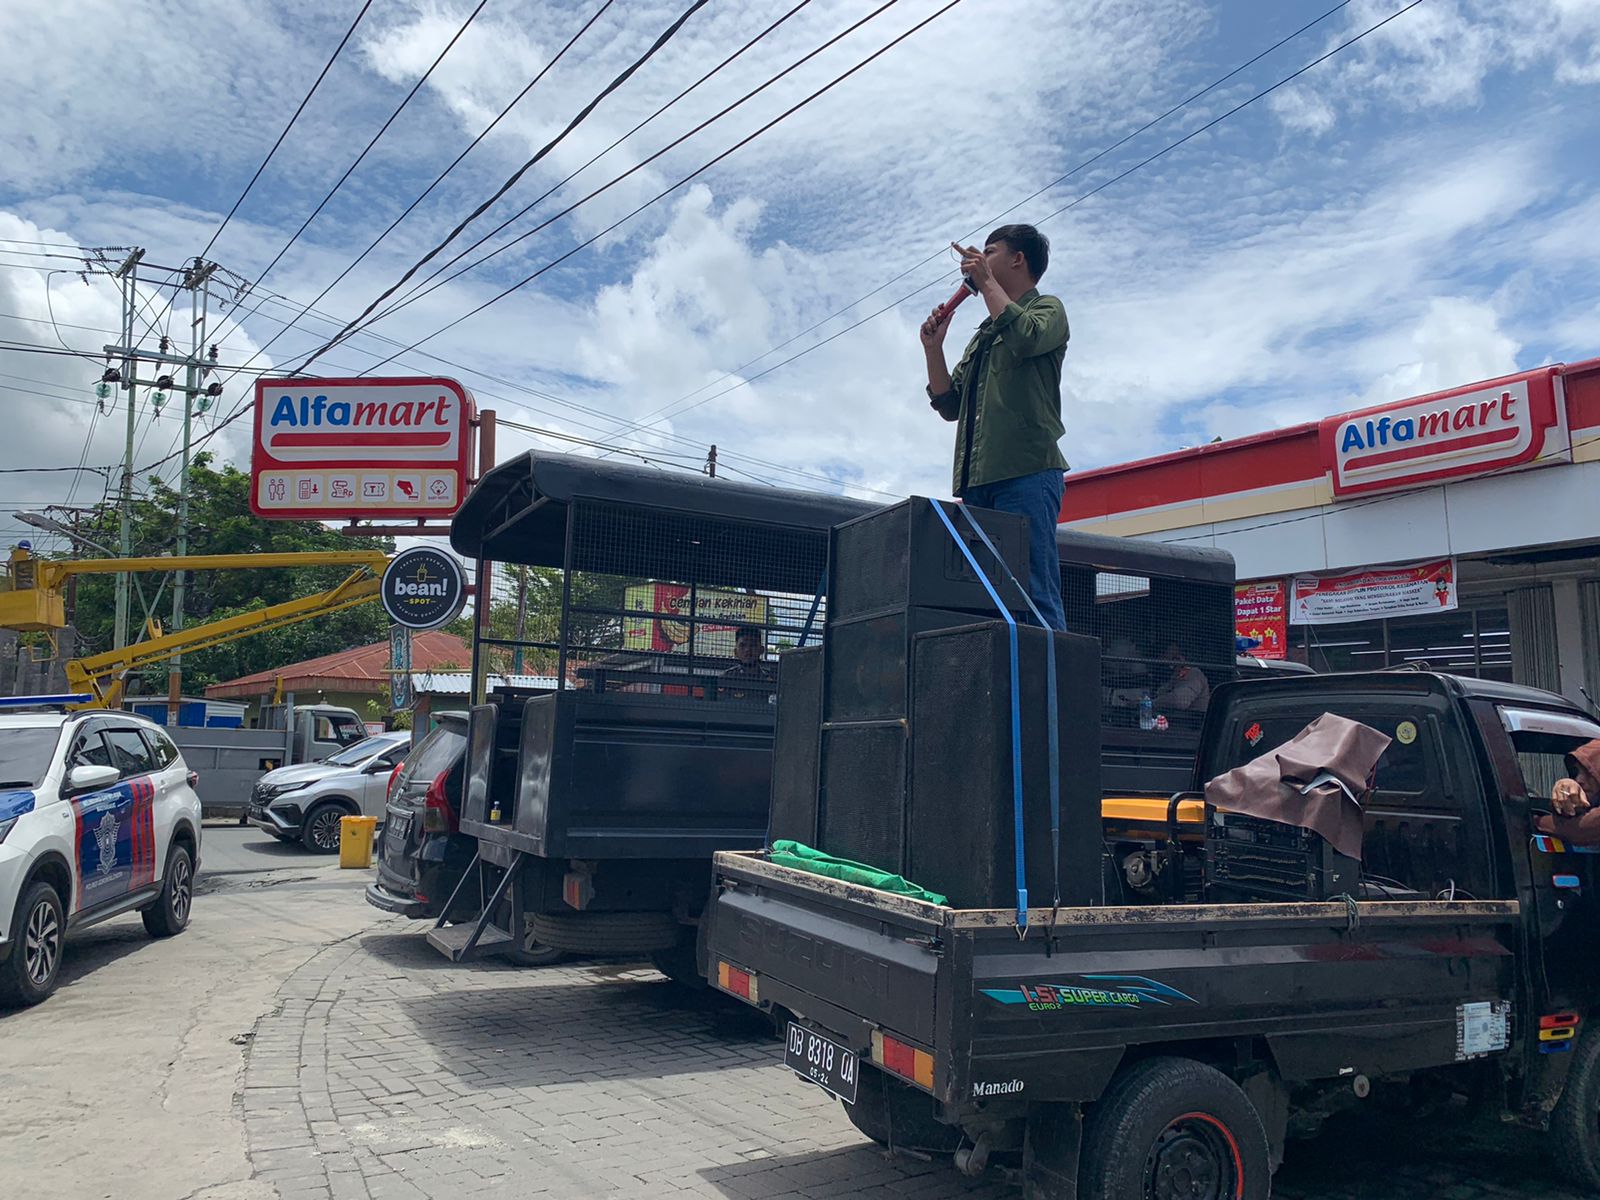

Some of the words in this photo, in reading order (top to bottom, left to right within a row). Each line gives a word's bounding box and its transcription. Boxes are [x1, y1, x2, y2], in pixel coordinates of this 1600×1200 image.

[270, 395, 451, 426] Alfamart
[1341, 391, 1517, 453] Alfamart
[394, 577, 448, 597] bean!
[1235, 597, 1256, 606] Paket
[1256, 596, 1274, 604] Data
[1237, 608, 1258, 617] Dapat
[1260, 606, 1264, 614] 1
[1265, 605, 1282, 613] Star
[1059, 988, 1109, 1003] SUPER
[1109, 992, 1140, 1003] CARGO
[789, 1026, 804, 1056] DB
[807, 1035, 834, 1071] 8318
[841, 1052, 854, 1085] QA
[972, 1079, 1024, 1097] Manado
